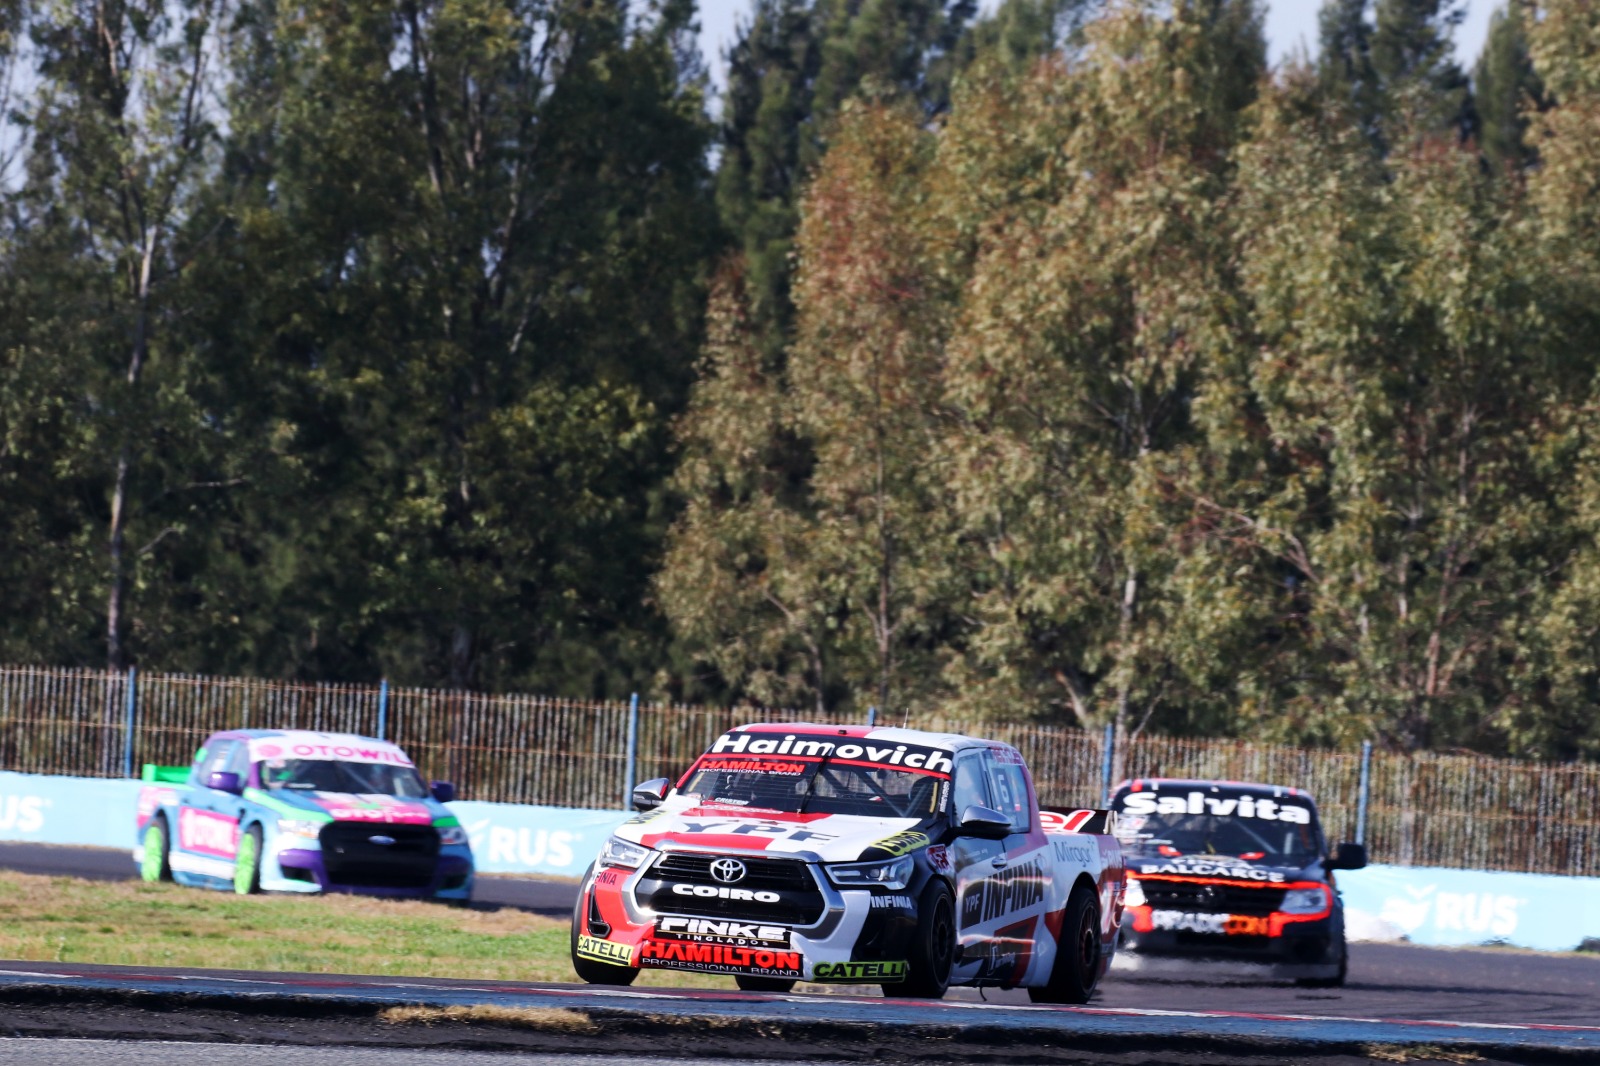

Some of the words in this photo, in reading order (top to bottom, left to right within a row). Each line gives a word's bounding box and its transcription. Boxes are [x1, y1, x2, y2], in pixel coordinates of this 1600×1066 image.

[293, 745, 412, 765] OTOWIL
[711, 735, 953, 774] Haimovich
[699, 760, 806, 772] HAMILTON
[0, 794, 44, 832] US
[1122, 791, 1311, 824] Salvita
[683, 822, 840, 842] YPF
[488, 826, 574, 867] RUS
[1141, 864, 1285, 883] BALCARCE
[672, 883, 781, 903] COIRO
[965, 893, 981, 914] YPF
[982, 859, 1044, 922] INFINIA
[870, 895, 913, 910] INFINIA
[1435, 892, 1519, 935] RUS
[675, 933, 769, 946] TINGLADOS
[642, 941, 800, 970] HAMILTON
[641, 957, 742, 973] PROFESSIONAL
[750, 967, 799, 977] BRAND
[813, 962, 906, 978] CATELLI
